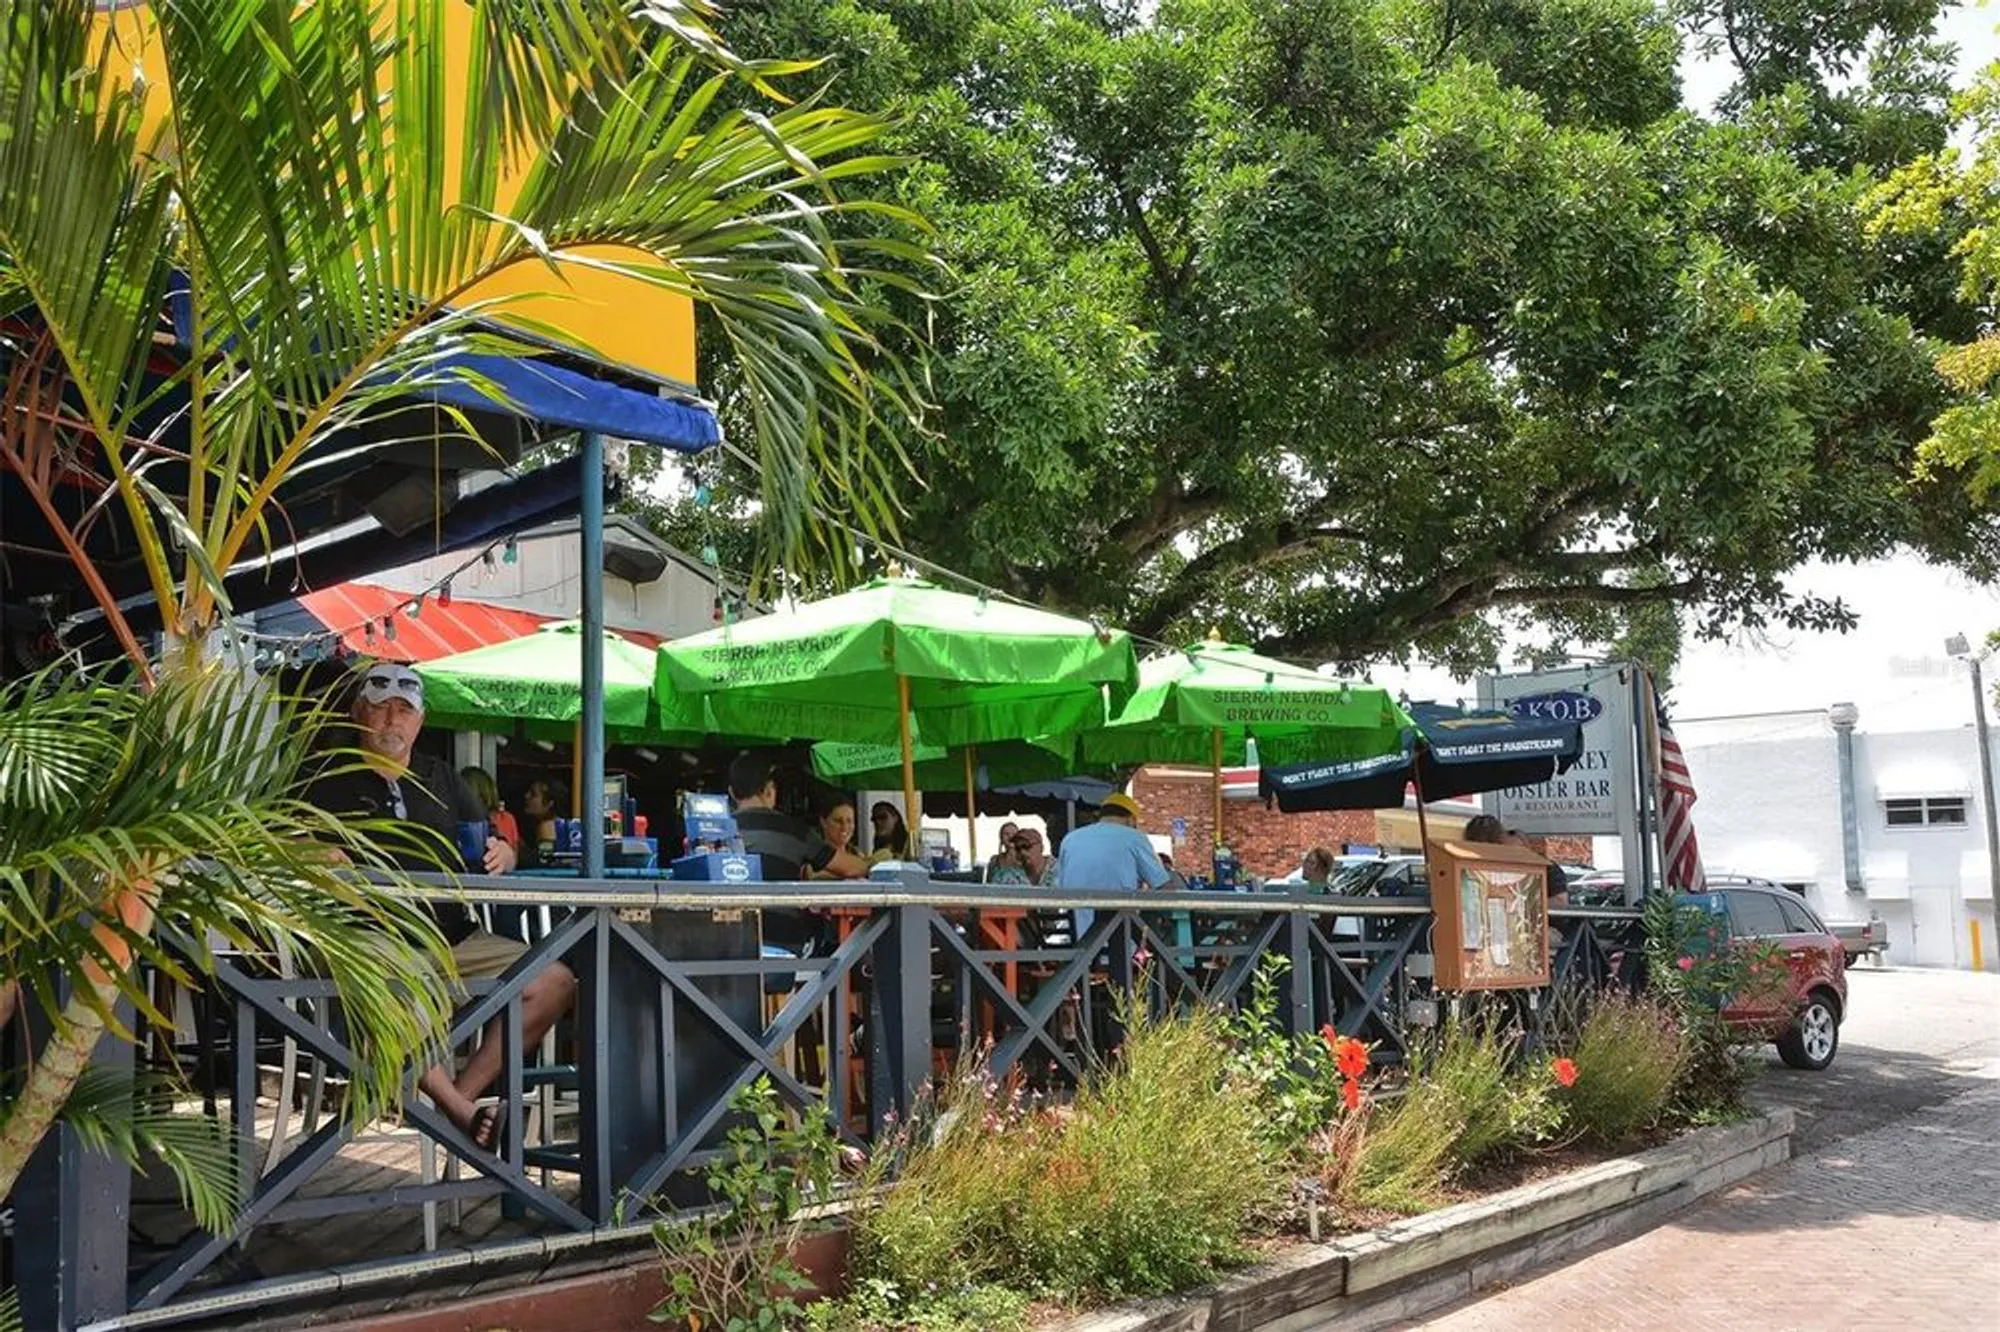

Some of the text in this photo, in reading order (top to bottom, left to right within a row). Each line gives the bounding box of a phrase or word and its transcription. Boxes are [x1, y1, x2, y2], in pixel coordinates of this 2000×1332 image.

[713, 660, 797, 683] BREWING
[1213, 690, 1346, 706] SIERRA NEVADA
[1227, 707, 1332, 723] BREWING CO.
[1503, 779, 1611, 800] OYSTER BAR
[1525, 800, 1599, 812] RESTAURANT
